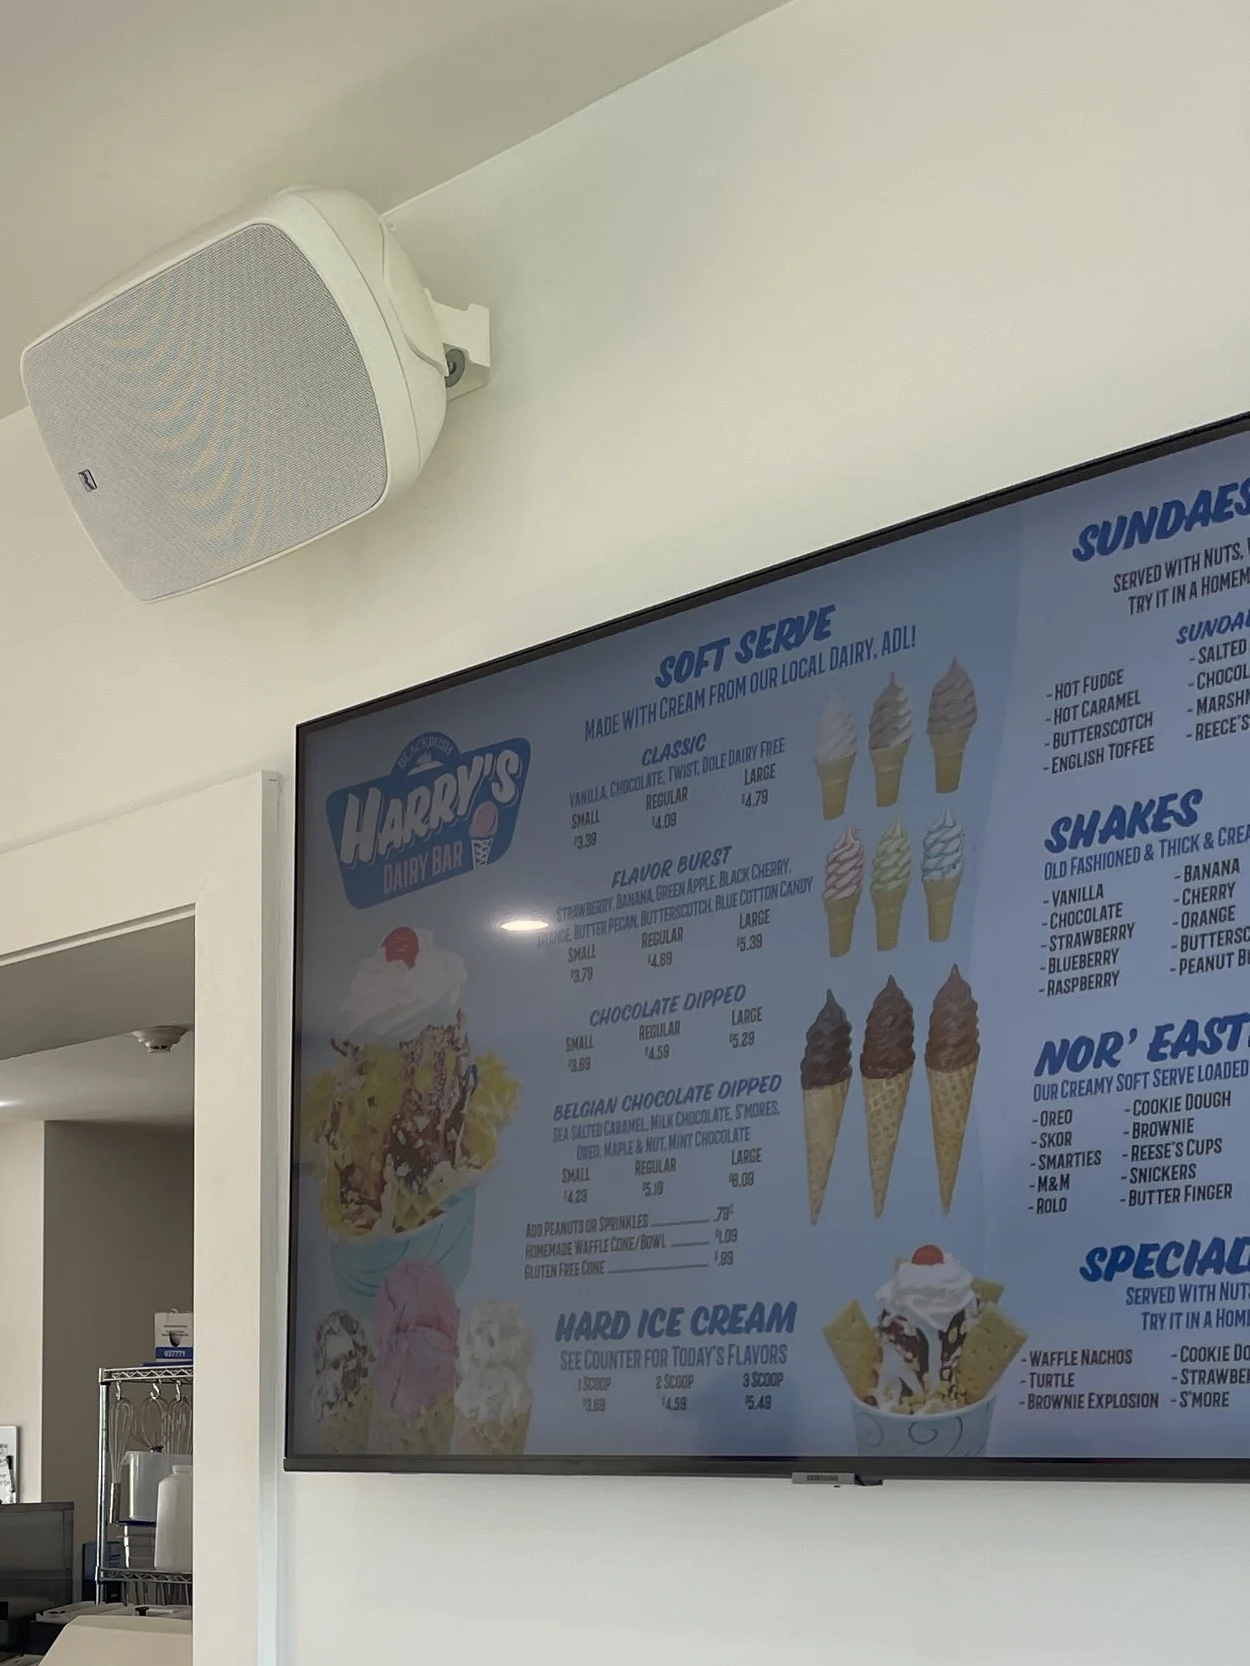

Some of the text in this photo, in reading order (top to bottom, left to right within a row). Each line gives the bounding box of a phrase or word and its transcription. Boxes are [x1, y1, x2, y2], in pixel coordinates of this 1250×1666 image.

[1113, 553, 1200, 594] SERVED WITH
[1129, 581, 1197, 616] TRY IT IN A
[655, 604, 835, 688] SOFT SERVE
[1198, 638, 1247, 664] SALTED
[584, 624, 916, 742] MADE WITH CREAM FROM OUR LOCAL DAIRY, ADL!
[1054, 668, 1125, 701] HOT FUDGE
[1054, 689, 1141, 726] HOT CARAMEL
[1052, 711, 1154, 750] BUTTERSCOTCH
[642, 733, 706, 766] CLASSIC
[728, 743, 758, 767] DAIRY
[760, 737, 785, 758] FREE
[1051, 736, 1155, 774] ENGLISH TOFFEE
[340, 749, 519, 864] HARRY'S
[571, 763, 776, 830] SMALL REGULAR LARGE
[1044, 788, 1203, 853] SHAKES
[384, 841, 462, 894] DAIRY BAR
[611, 845, 732, 889] FLAVOR BURST
[1044, 834, 1200, 881] OLD FASHIONED THICK
[1184, 858, 1240, 883] BANANA
[719, 866, 750, 891] BLACK
[779, 876, 814, 898] CANDY
[1051, 883, 1104, 907] VANILLA
[1182, 881, 1236, 906] CHERRY
[1050, 902, 1123, 930] CHOCOLATE
[1181, 905, 1235, 929] ORANGE
[568, 908, 771, 963] SMALL REGULAR LARGE
[1049, 922, 1135, 952] STRAWBERRY
[1048, 948, 1119, 974] BLUEBERRY
[1179, 952, 1234, 976] PEANUT
[1047, 970, 1120, 996] RASPBERRY
[589, 984, 747, 1027] CHOCOLATE DIPPED
[638, 1006, 763, 1041] REGULAR LARGE
[1146, 1012, 1250, 1062] EAST
[1033, 1059, 1249, 1102] OUR CREAMY SOFT SERVE LOADED
[553, 1074, 782, 1122] BELGIAN CHOCOLATE DIPPED
[1133, 1091, 1232, 1117] COOKIE DOUGH
[1040, 1109, 1073, 1127] OREO
[1132, 1117, 1195, 1140] BROWNIE
[1039, 1131, 1072, 1149] SKOR
[1131, 1138, 1223, 1162] REESE'S CUPS
[635, 1147, 762, 1176] REGULAR LARGE
[1038, 1150, 1102, 1171] SMARTIES
[1037, 1173, 1070, 1193] M&M
[1129, 1163, 1197, 1185] SNICKERS
[1036, 1197, 1067, 1215] ROLO
[1128, 1183, 1233, 1207] BUTTER FINGER
[1126, 1283, 1216, 1306] SERVED WITH
[554, 1301, 798, 1342] HARD ICE CREAM
[1141, 1310, 1212, 1331] TRY IT IN A
[560, 1344, 788, 1371] SEE COUNTER FOR TODAY'S FLAVORS
[1029, 1349, 1133, 1367] WAFFLE NACHOS
[1180, 1345, 1230, 1363] COOKIE
[742, 1372, 784, 1388] 3 SCOOP
[1029, 1372, 1075, 1389] TURTLE
[1027, 1392, 1159, 1410] BROWNIE EXPLOSION
